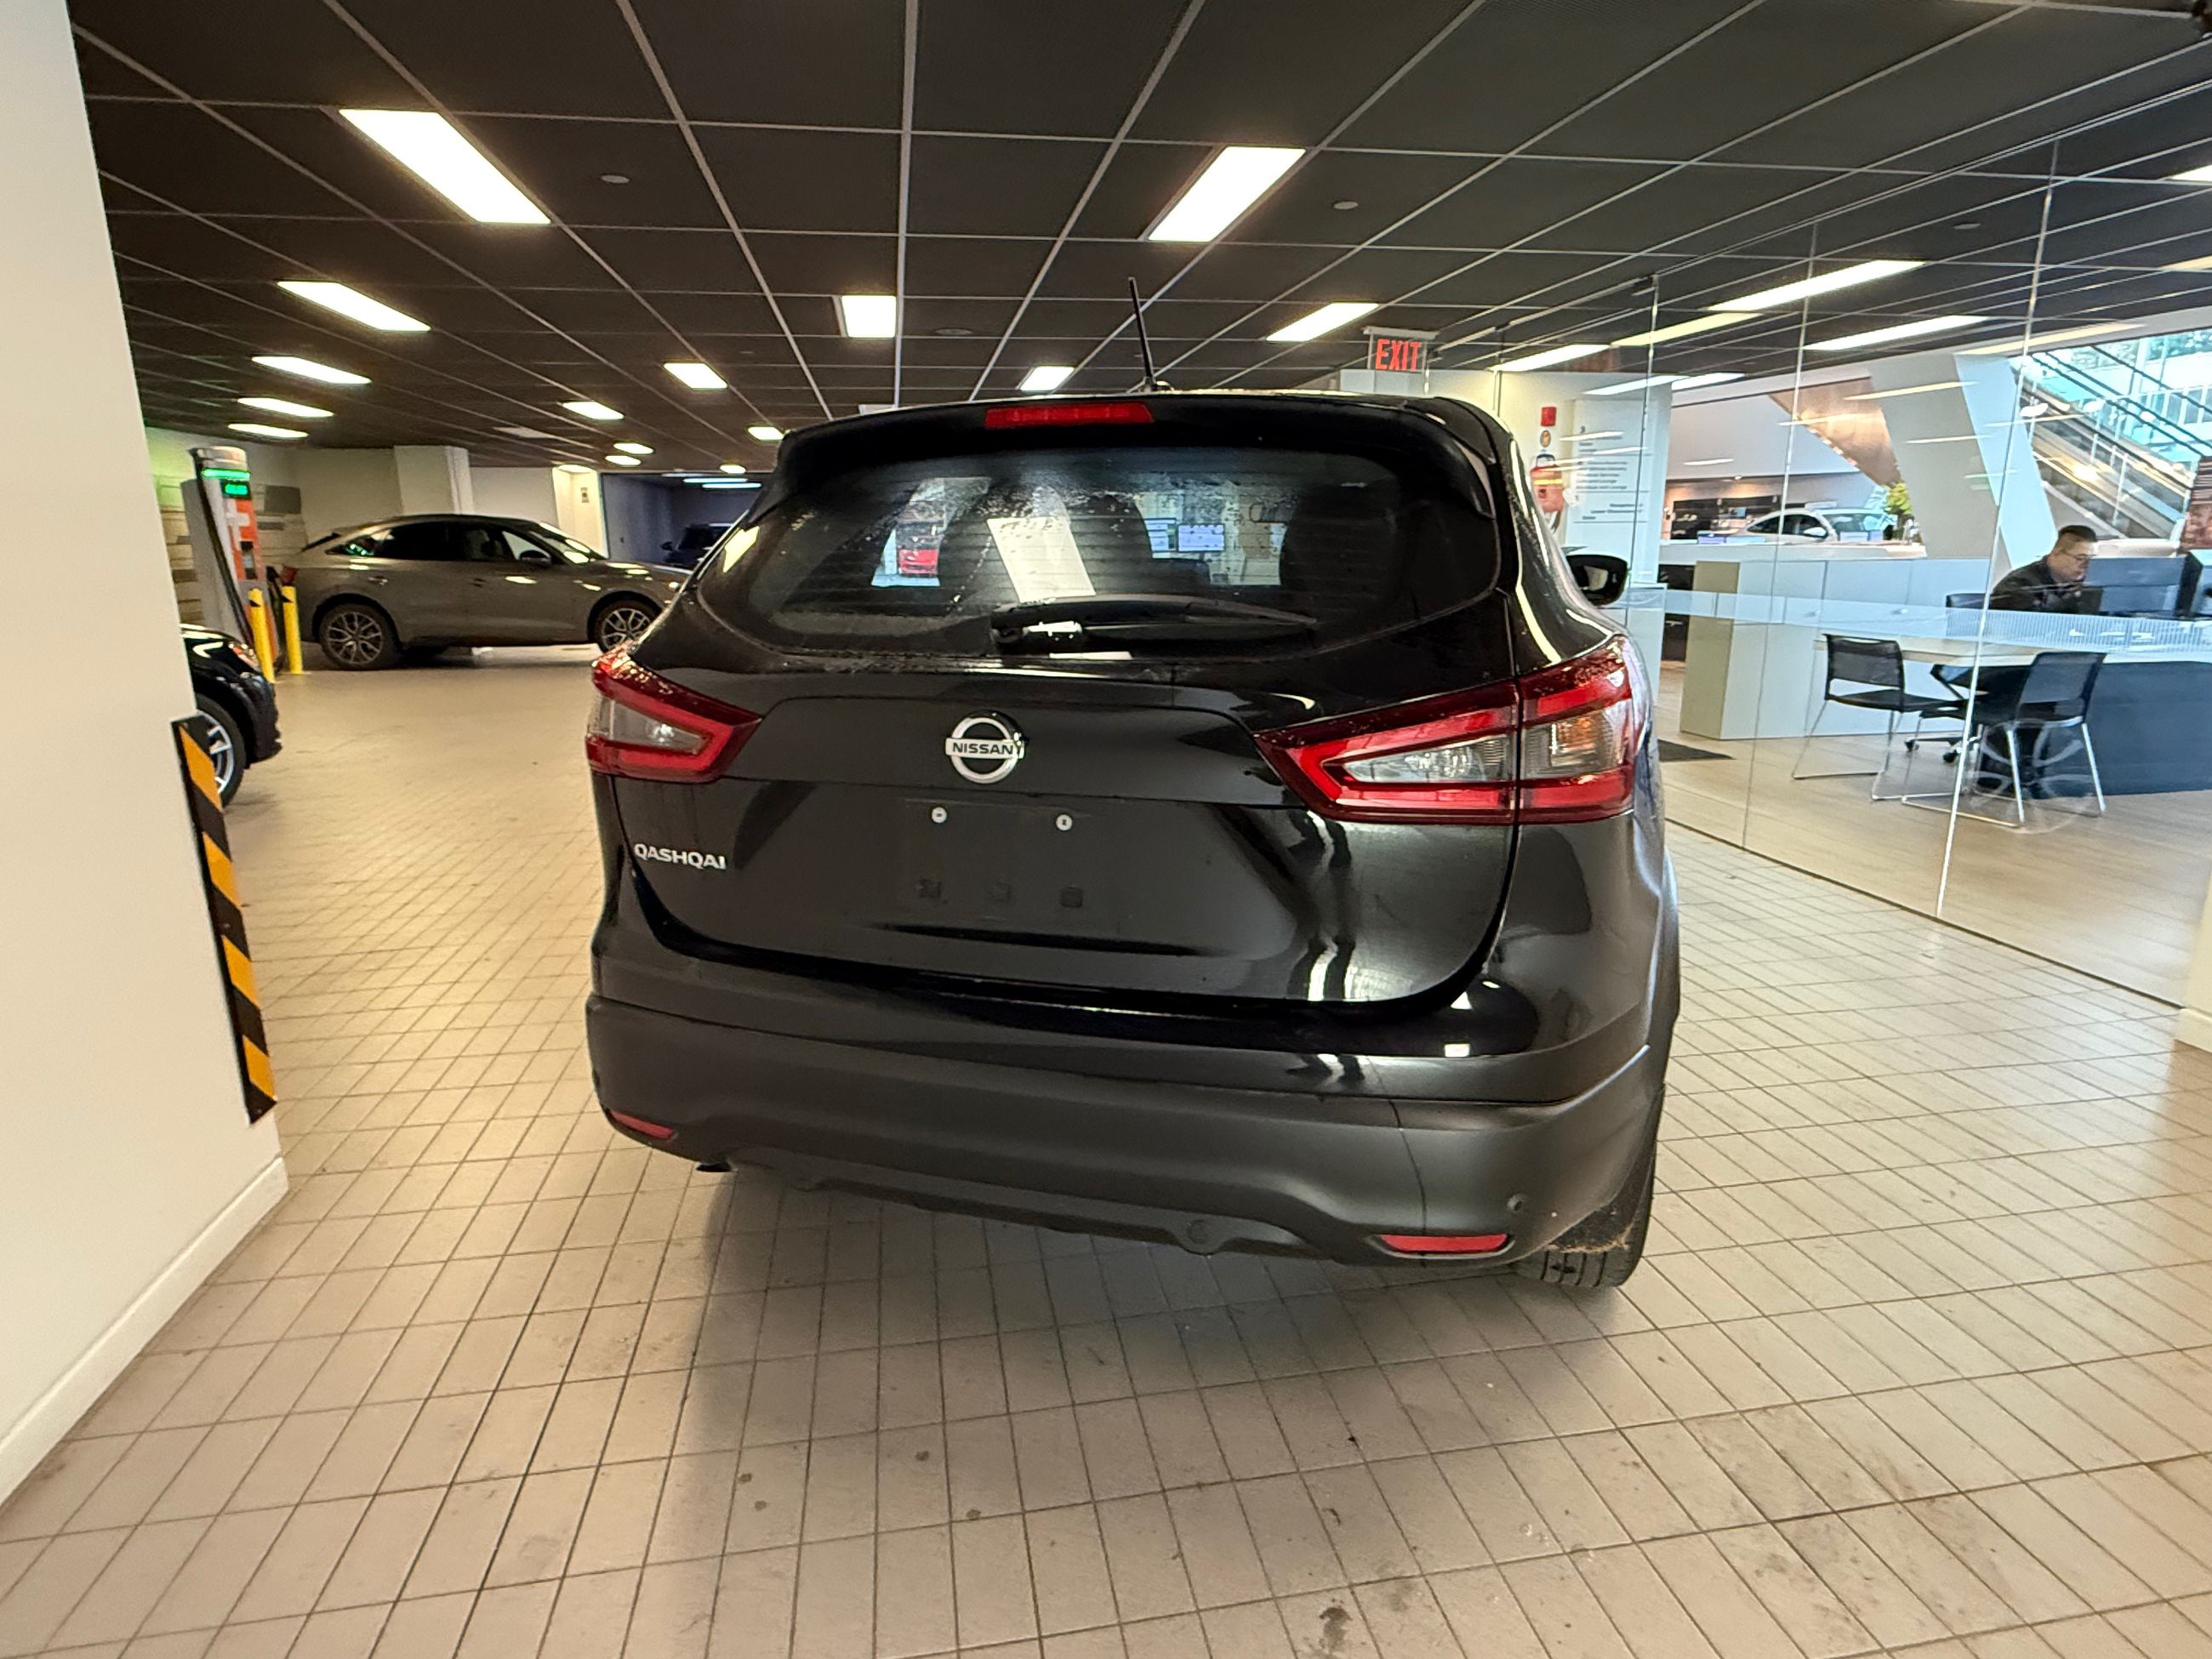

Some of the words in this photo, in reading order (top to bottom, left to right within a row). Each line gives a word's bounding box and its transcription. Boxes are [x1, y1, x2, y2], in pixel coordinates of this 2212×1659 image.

[1375, 338, 1422, 372] EXIT
[952, 742, 1014, 755] NISSAN
[634, 843, 727, 869] QASHQAI
